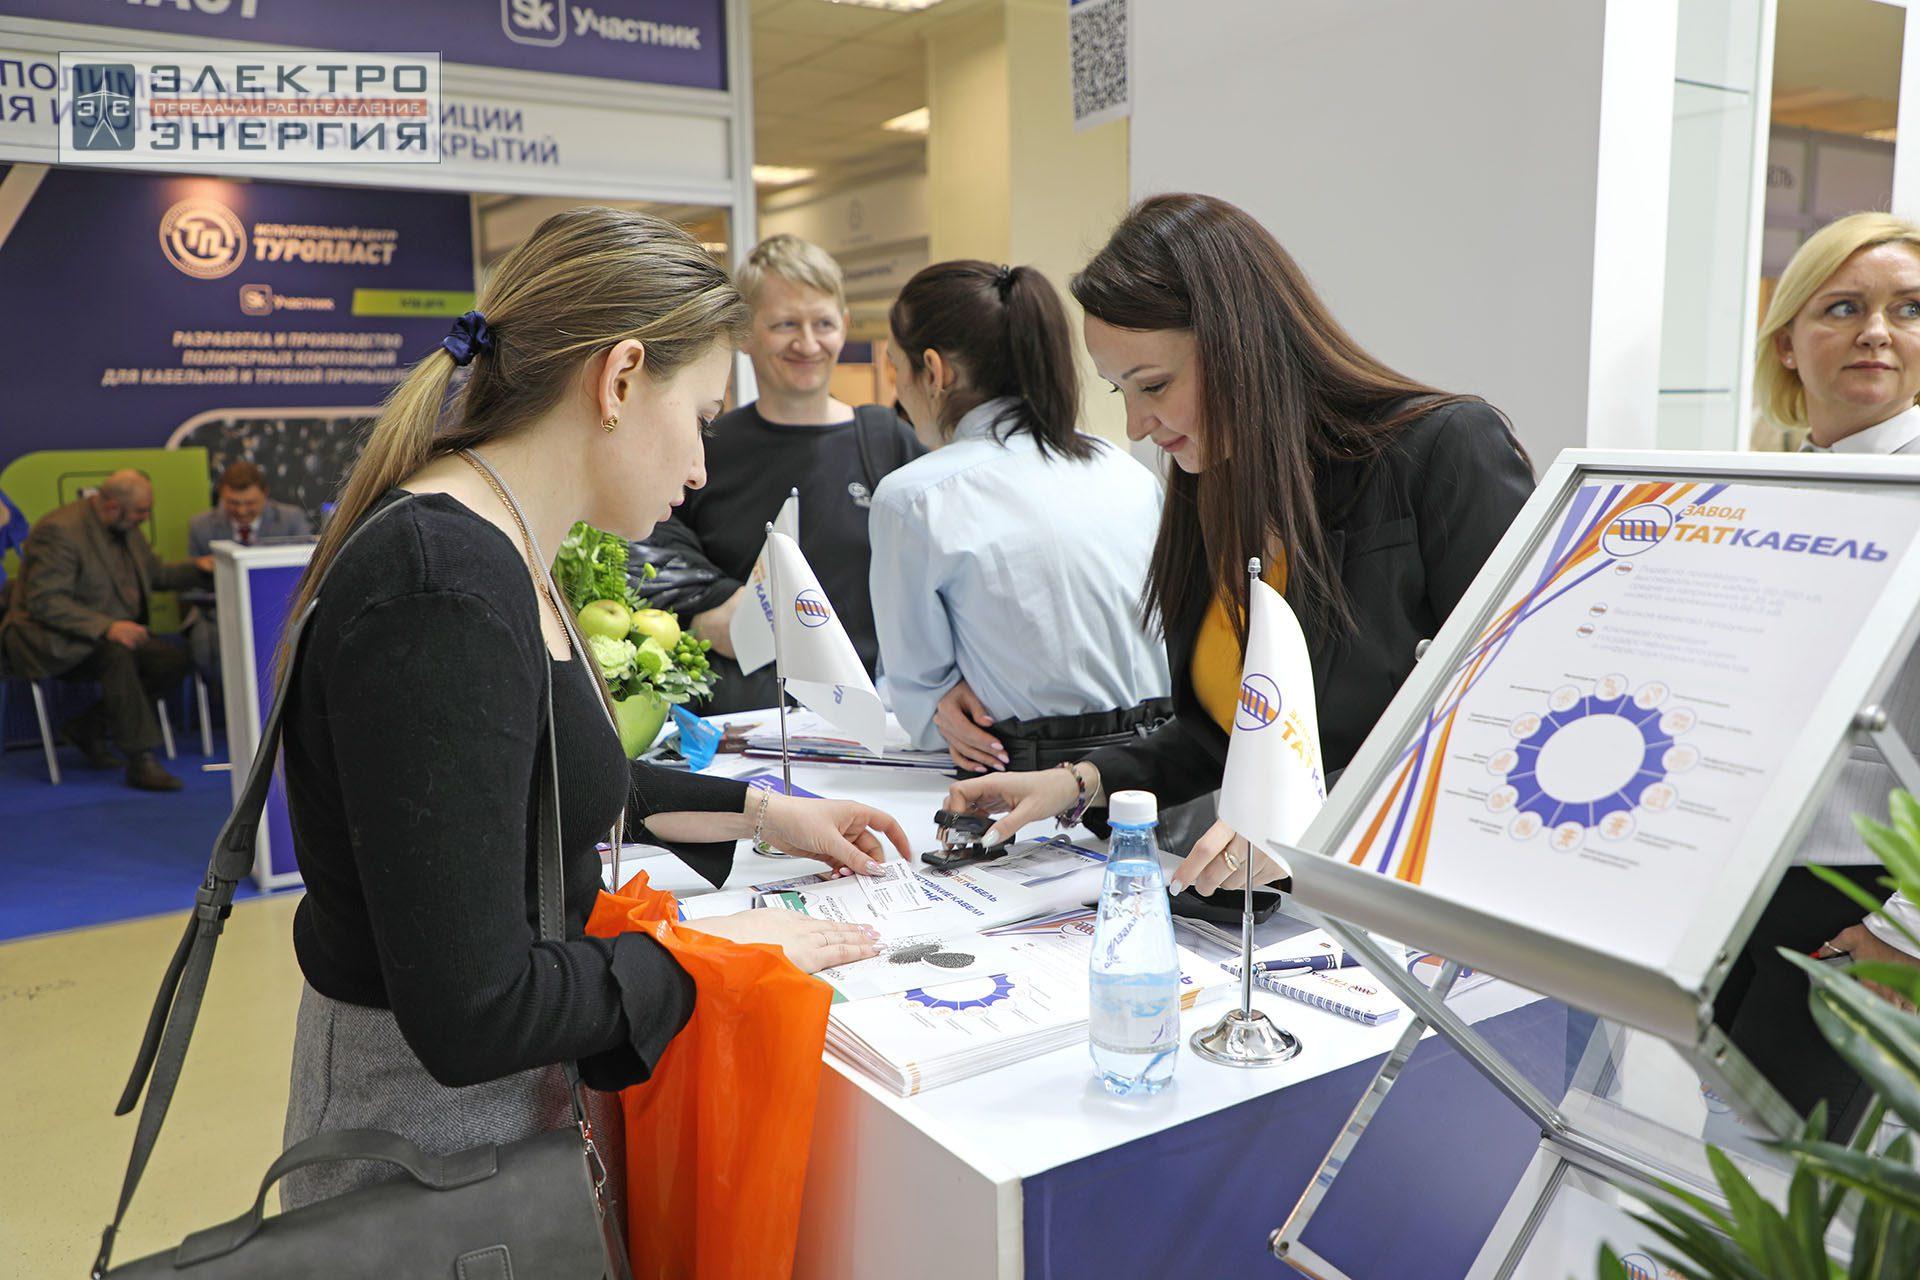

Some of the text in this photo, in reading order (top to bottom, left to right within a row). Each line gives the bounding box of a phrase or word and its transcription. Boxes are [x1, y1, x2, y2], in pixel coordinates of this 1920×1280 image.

[571, 6, 701, 50] Участник
[253, 238, 397, 265] ТУРОПЛАСТ
[1683, 505, 1747, 521] ЗАВОД
[1674, 524, 1888, 563] ТАТКАБЕЛЬ
